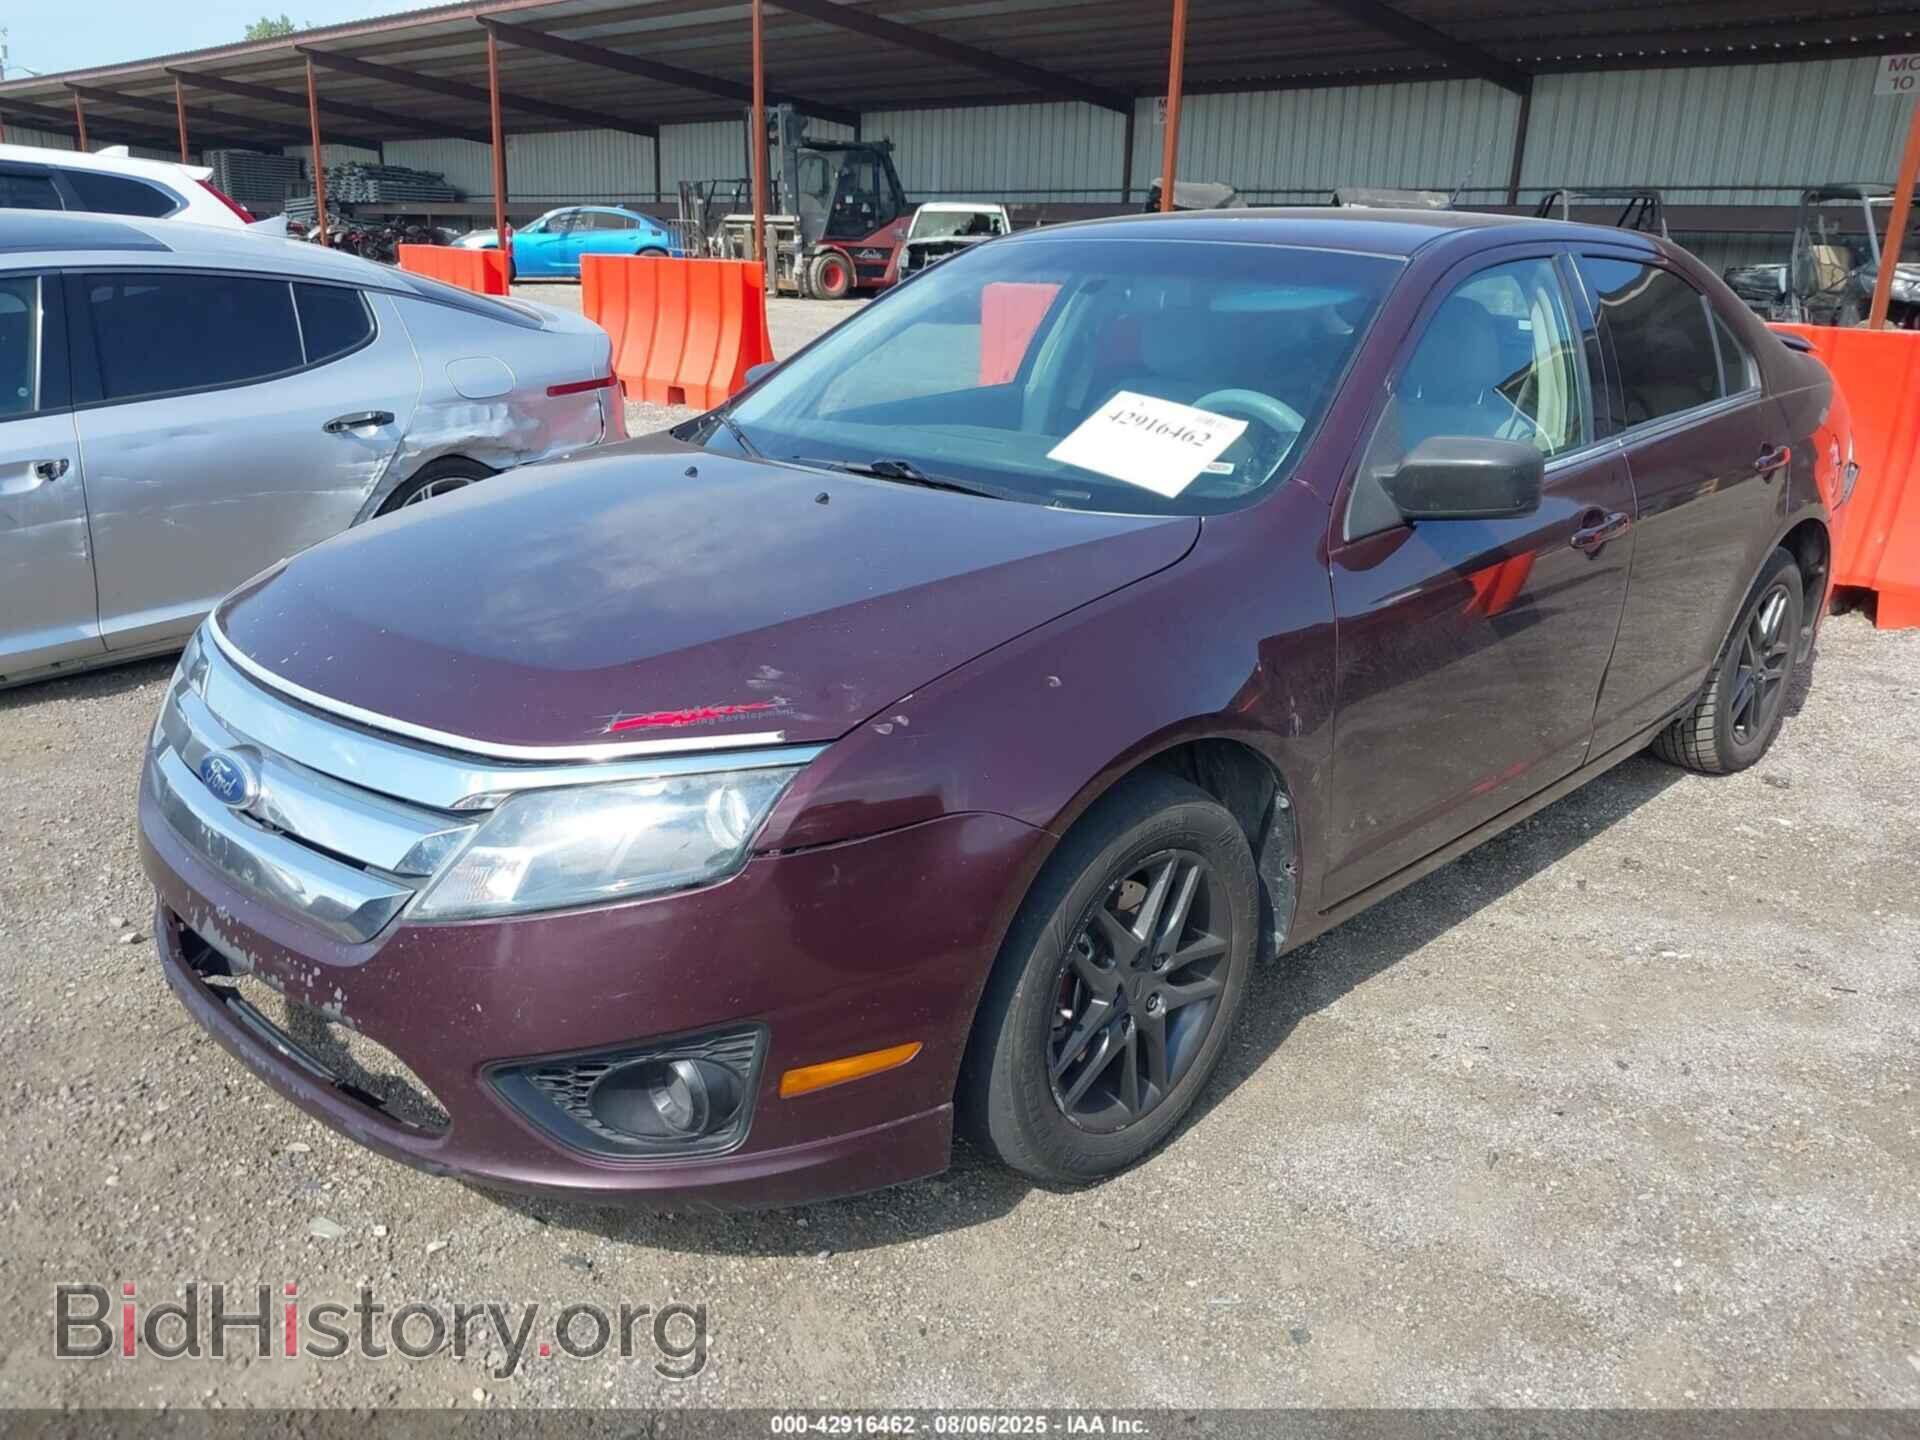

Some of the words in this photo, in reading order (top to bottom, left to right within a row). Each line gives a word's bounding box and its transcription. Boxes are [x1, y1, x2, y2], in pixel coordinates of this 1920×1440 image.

[1889, 76, 1914, 90] 10
[1109, 409, 1212, 447] 42916462
[206, 758, 237, 797] Ford
